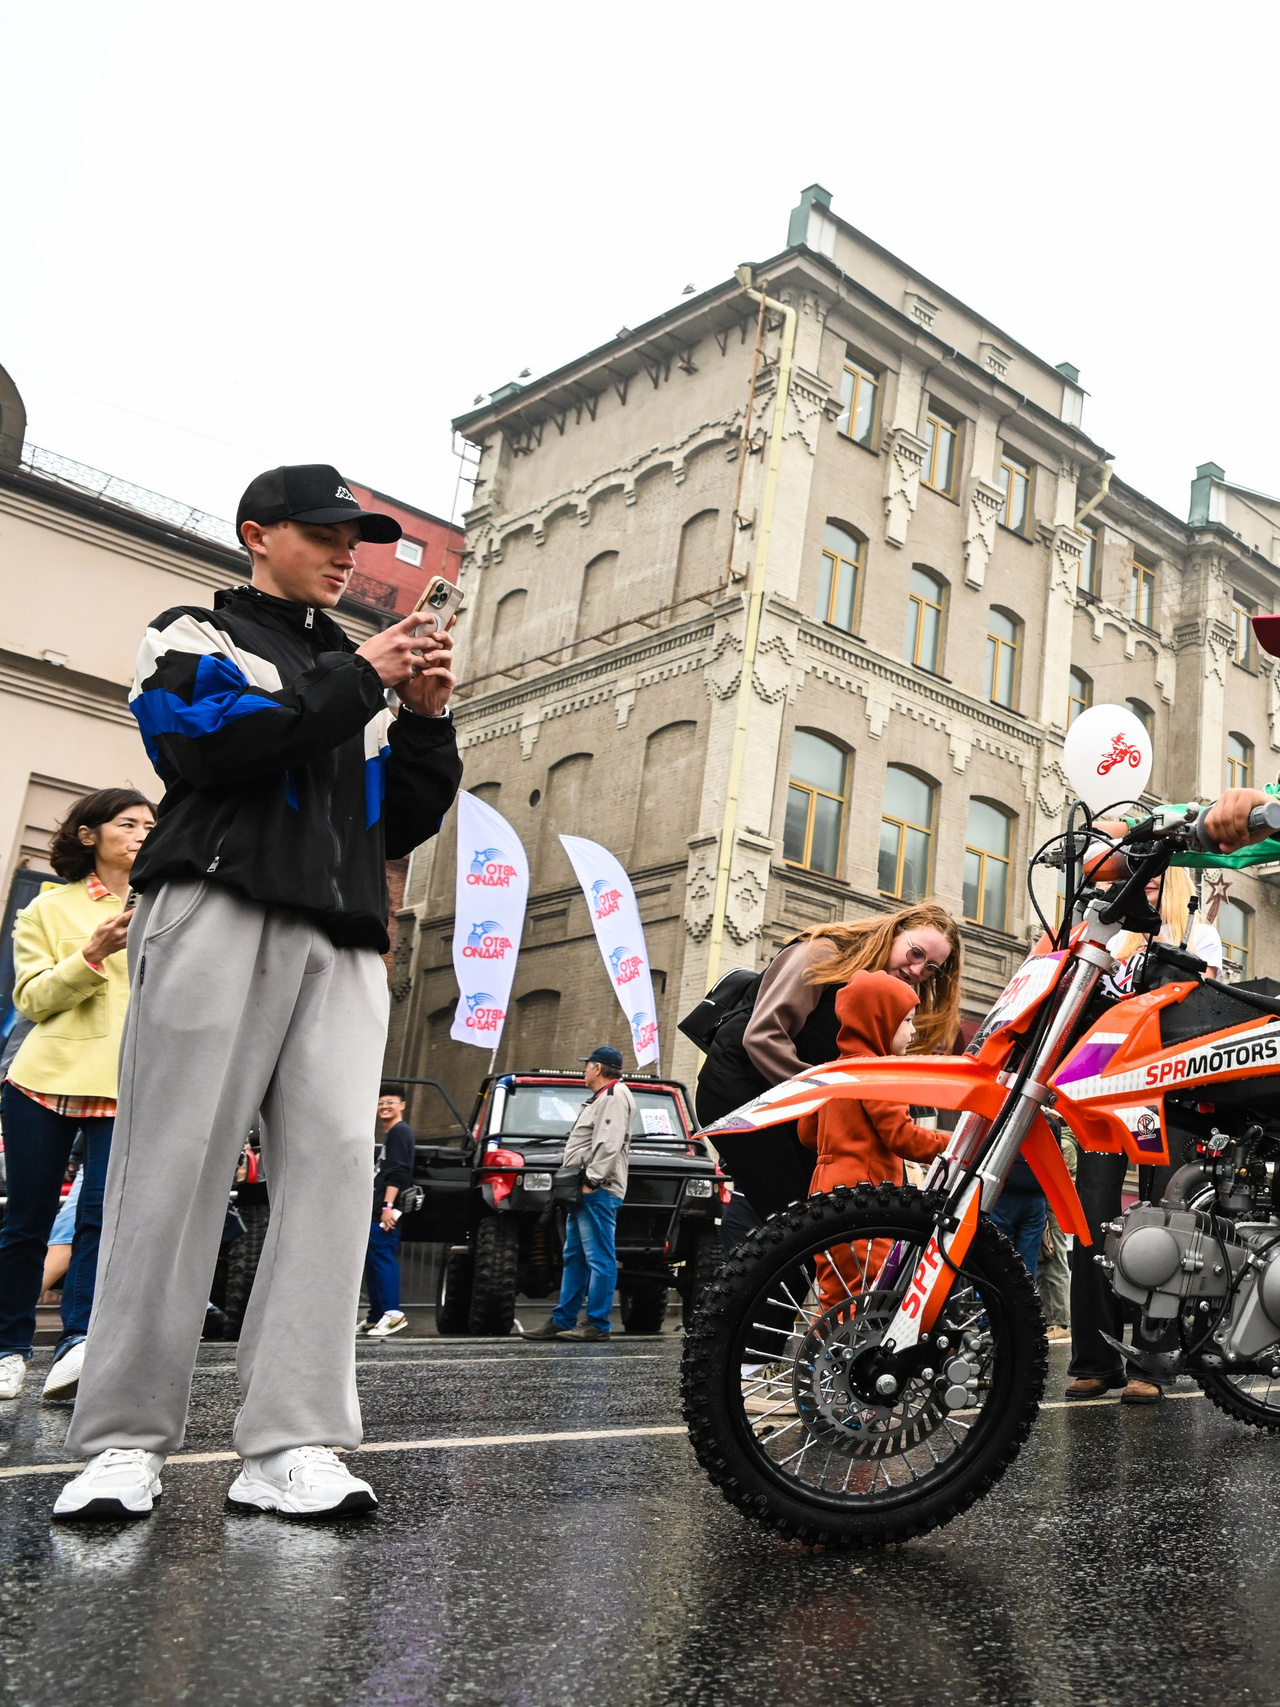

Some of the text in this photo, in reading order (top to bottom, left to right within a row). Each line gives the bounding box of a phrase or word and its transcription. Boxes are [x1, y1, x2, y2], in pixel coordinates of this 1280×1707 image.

[994, 974, 1031, 1008] PR
[1146, 1039, 1277, 1085] SPRMOTORS
[901, 1237, 941, 1319] SPR
